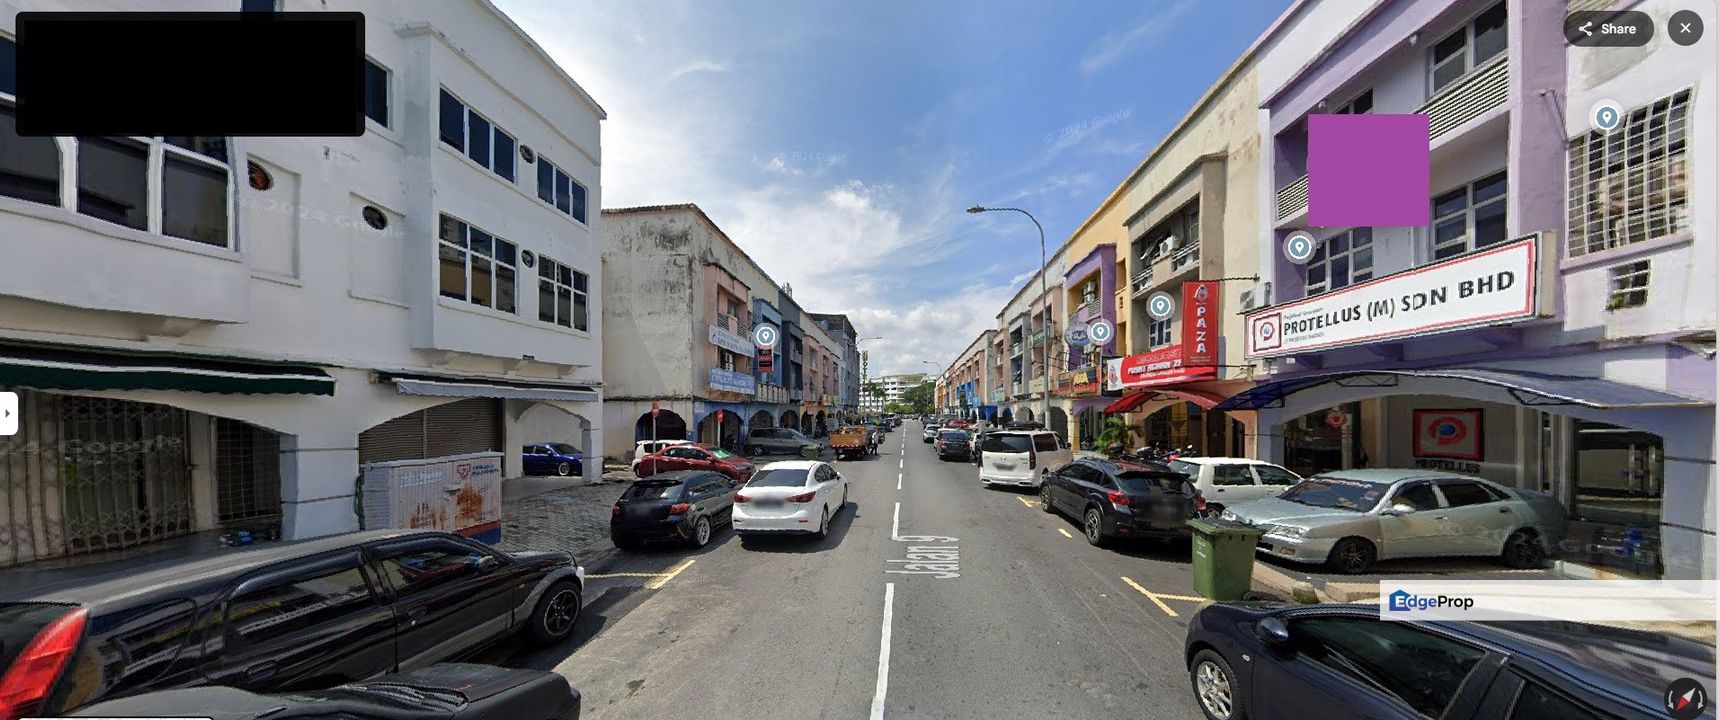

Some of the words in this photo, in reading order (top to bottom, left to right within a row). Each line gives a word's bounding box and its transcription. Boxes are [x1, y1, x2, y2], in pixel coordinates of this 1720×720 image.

[1284, 304, 1362, 336] PROTELLUS
[1367, 296, 1396, 322] (M)
[1401, 286, 1448, 312] SDN
[1458, 270, 1515, 299] BHD
[885, 546, 960, 578] Jalan
